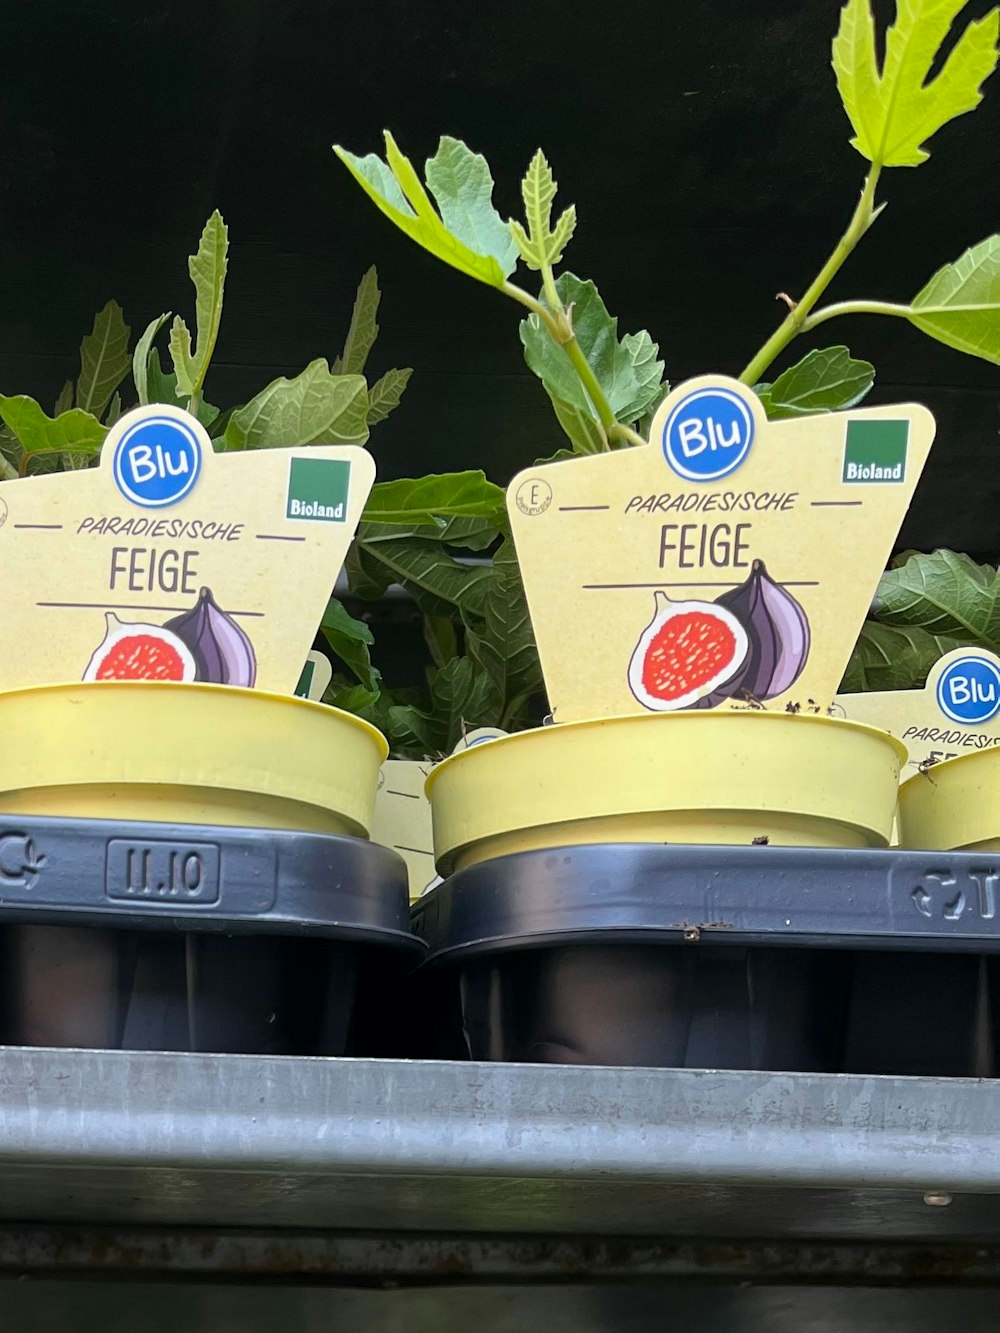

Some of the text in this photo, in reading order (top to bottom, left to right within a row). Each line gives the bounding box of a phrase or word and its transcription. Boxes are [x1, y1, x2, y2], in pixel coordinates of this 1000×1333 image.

[678, 417, 741, 458] Blu
[128, 445, 188, 484] Blu
[846, 462, 902, 480] Bioland
[289, 498, 343, 520] Bioland
[531, 485, 538, 505] E
[625, 492, 799, 514] PARADIESISCHE
[76, 516, 245, 542] PARADIESISCHE
[659, 523, 752, 568] FEIGE
[109, 547, 200, 594] FEIGE
[949, 676, 995, 704] Blu
[125, 847, 205, 897] 11.10
